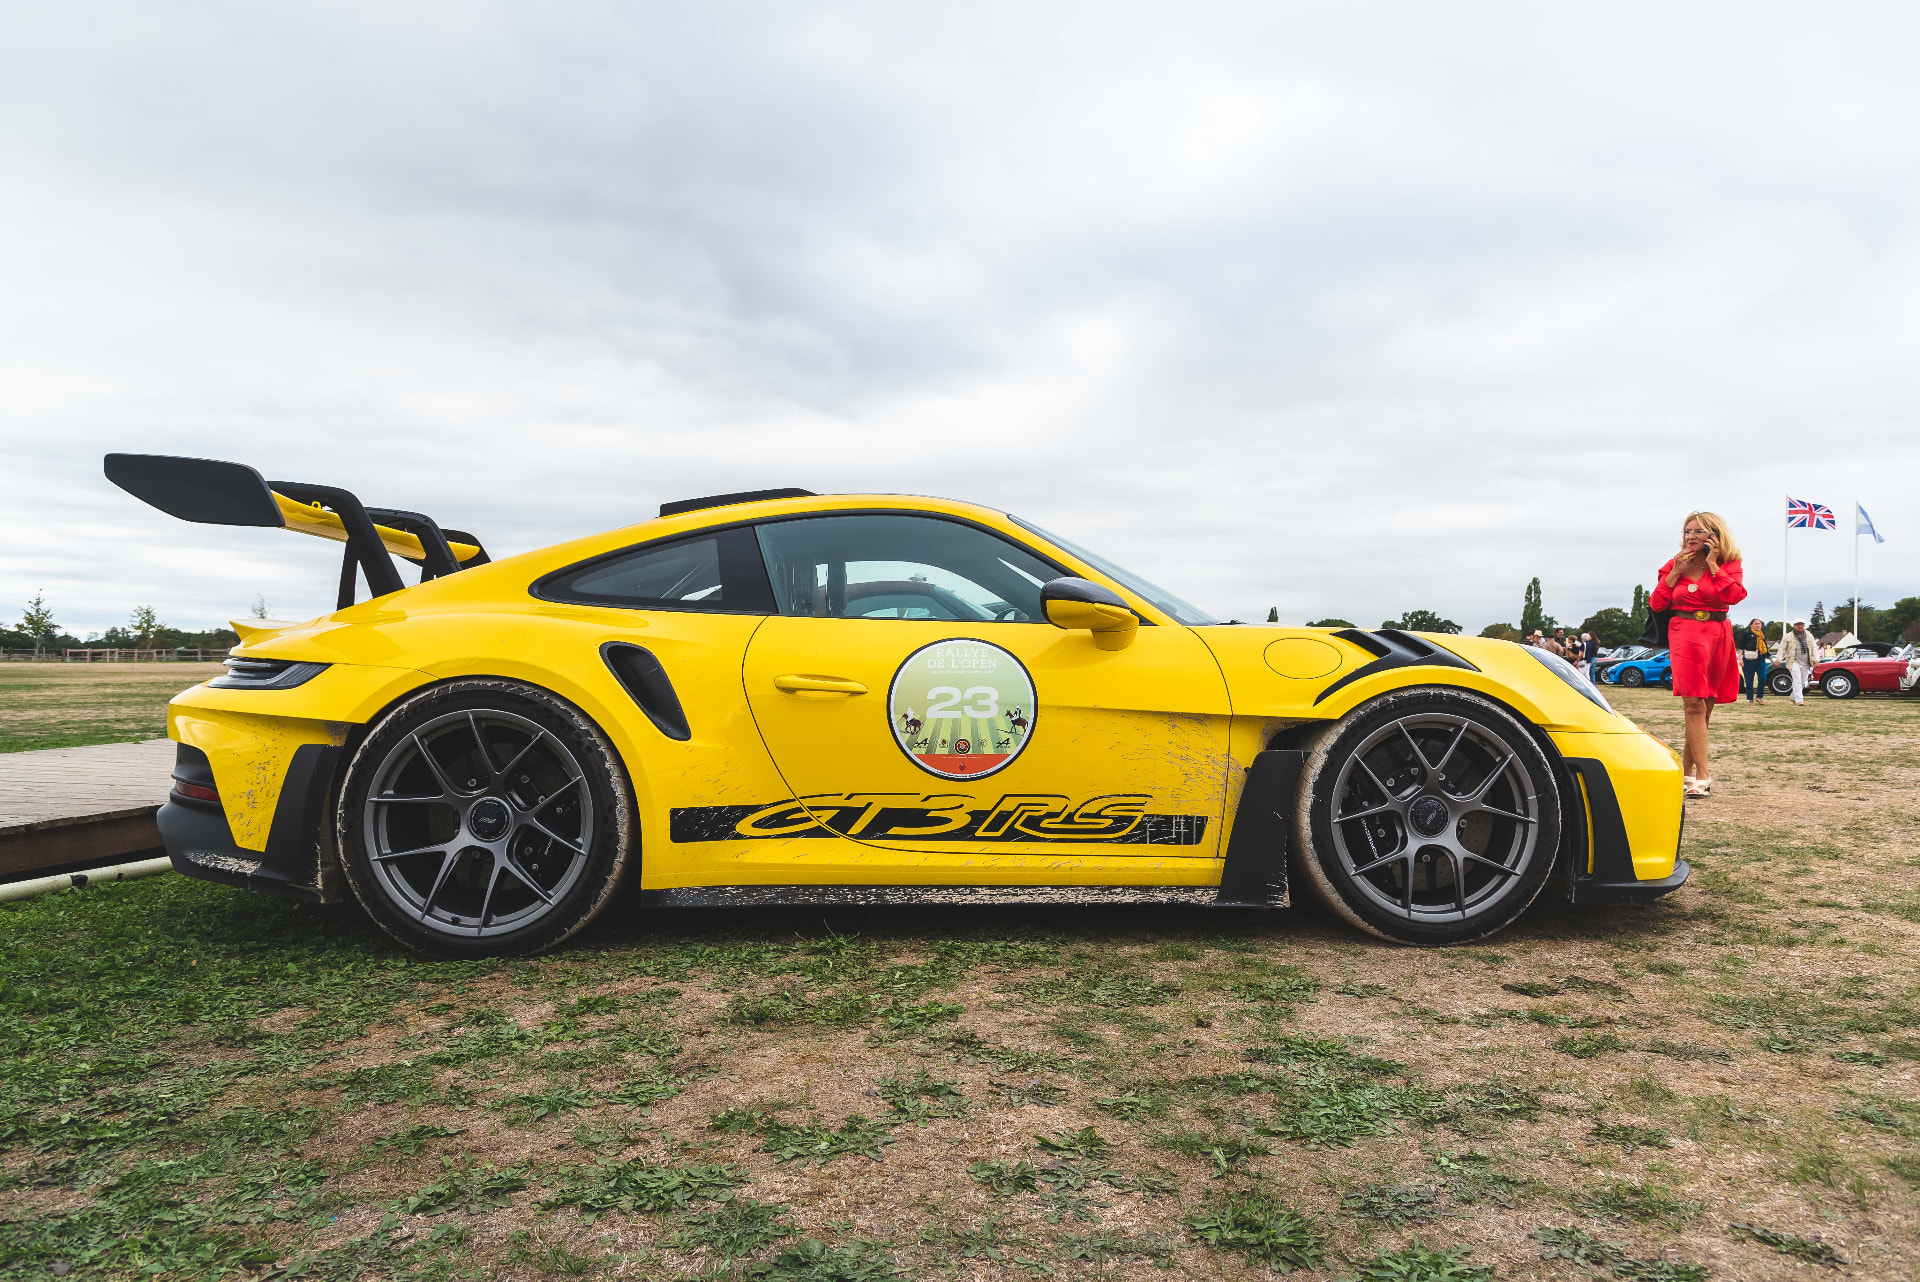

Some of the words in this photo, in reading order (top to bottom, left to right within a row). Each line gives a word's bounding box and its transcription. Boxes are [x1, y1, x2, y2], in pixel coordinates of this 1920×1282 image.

[936, 648, 988, 658] RALLYE
[927, 658, 945, 669] DE
[951, 658, 997, 669] L'OPEN
[926, 686, 999, 719] 23
